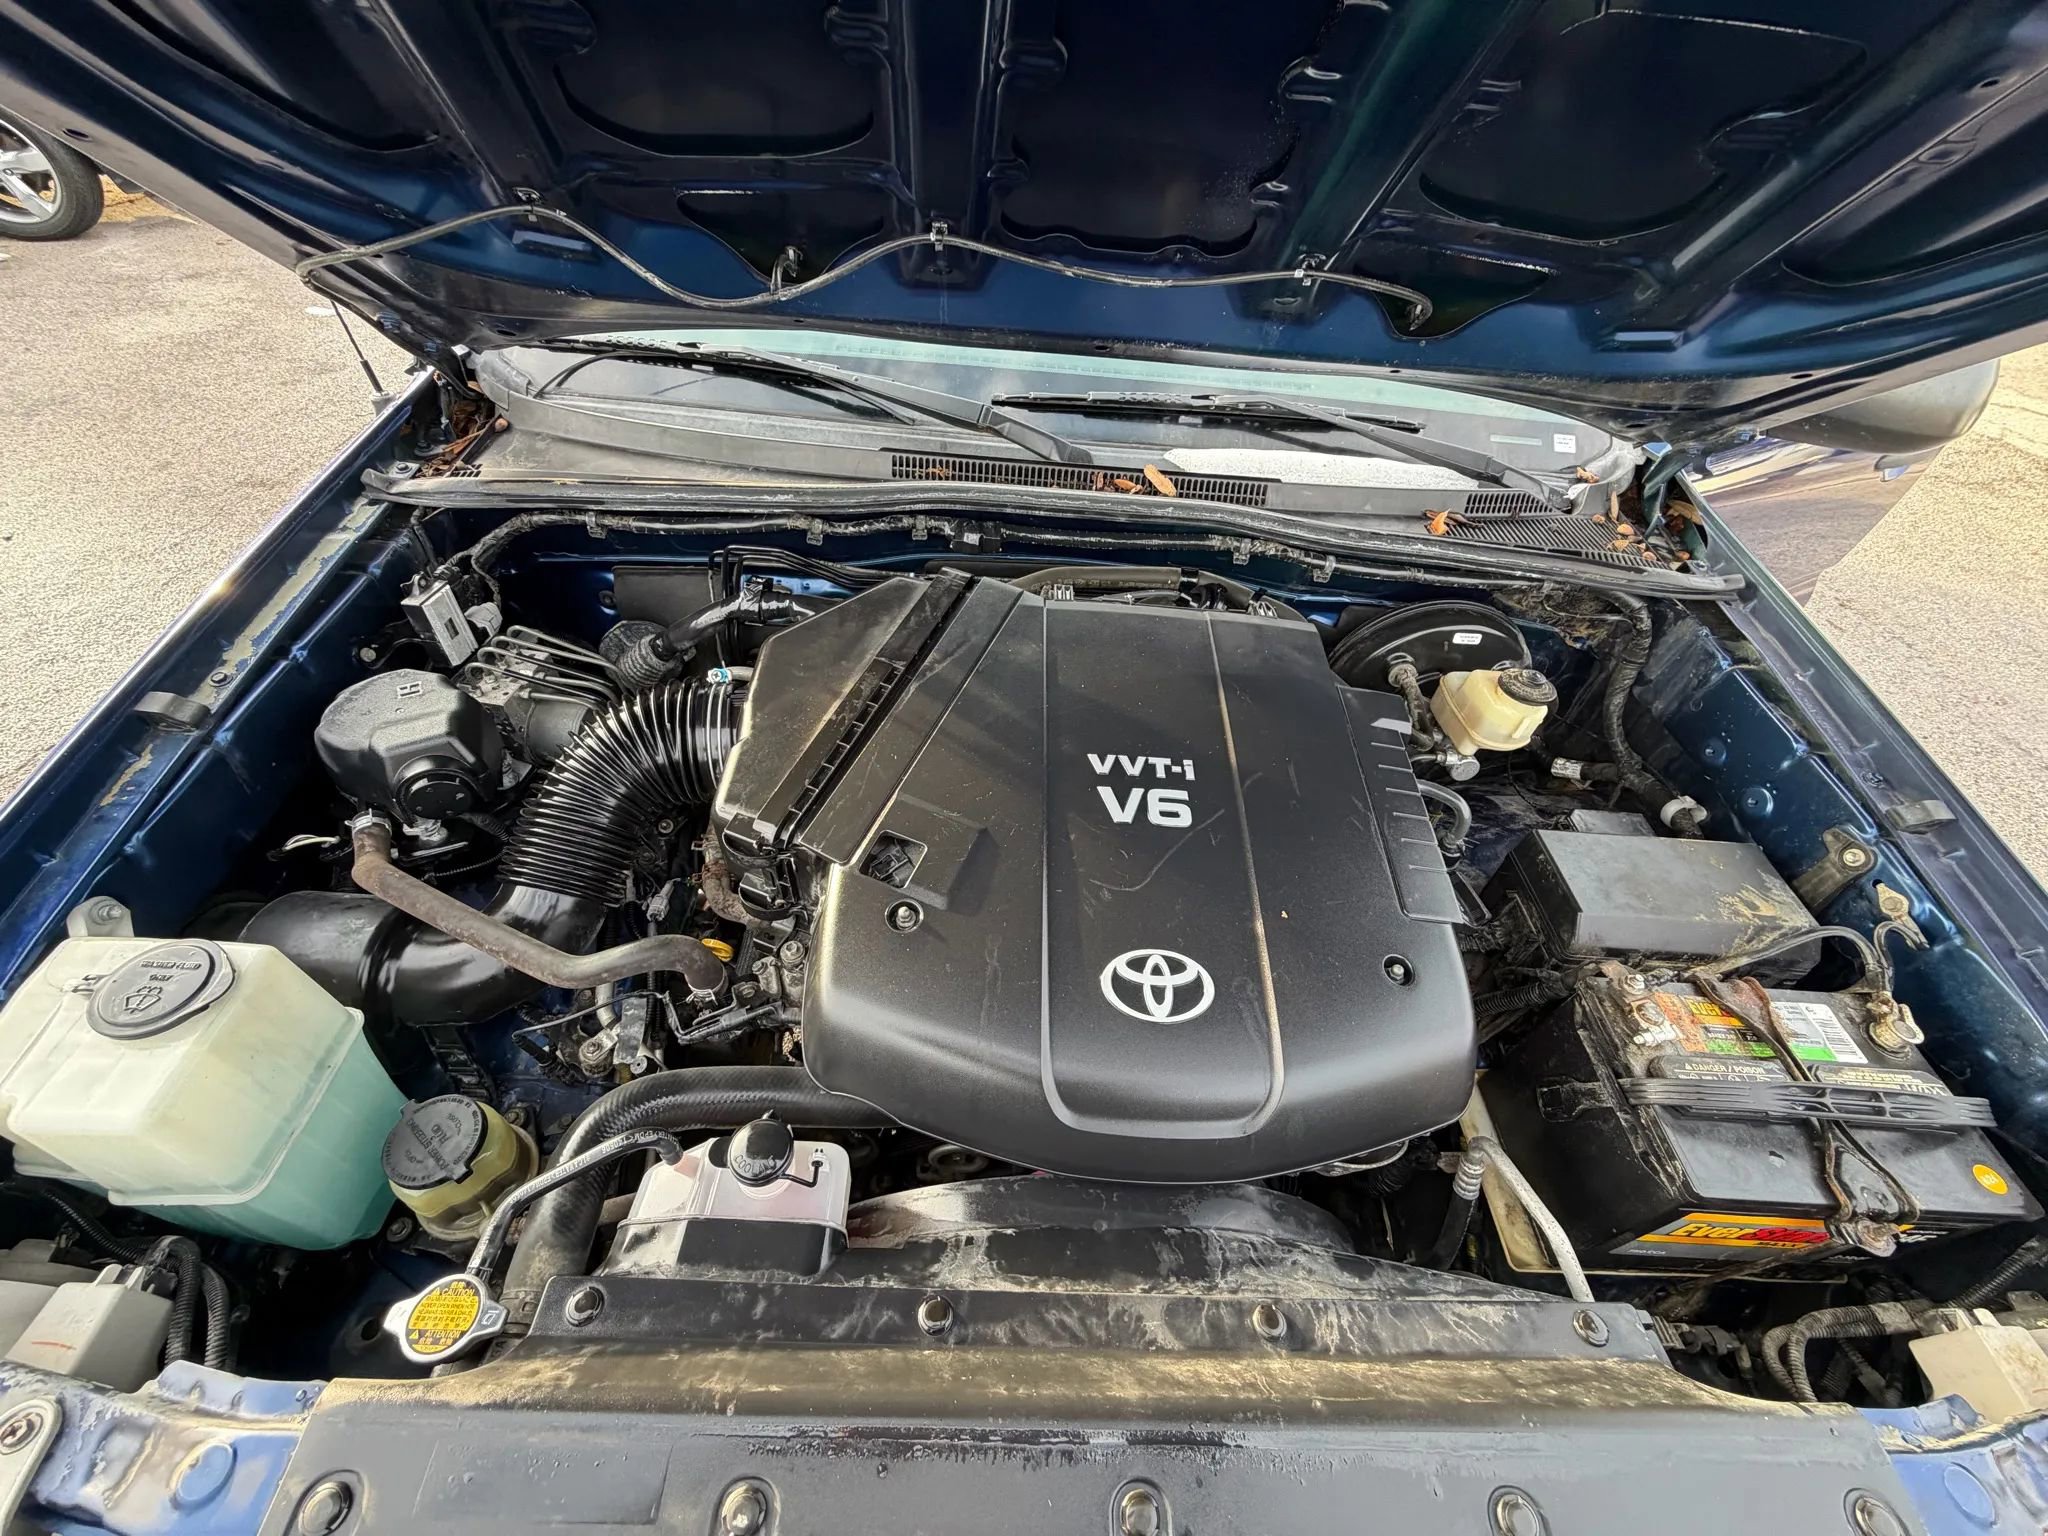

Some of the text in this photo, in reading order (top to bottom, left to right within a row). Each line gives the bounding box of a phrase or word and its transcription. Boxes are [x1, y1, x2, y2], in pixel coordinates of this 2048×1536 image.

[1087, 753, 1195, 781] VVT-i
[1096, 785, 1193, 828] V6
[176, 961, 203, 970] FLUID
[1692, 1063, 1727, 1072] DANGER
[1733, 1065, 1766, 1074] POISON
[426, 1145, 450, 1170] POWER
[441, 1288, 475, 1297] CAUTION
[424, 1329, 462, 1339] ATTENTION
